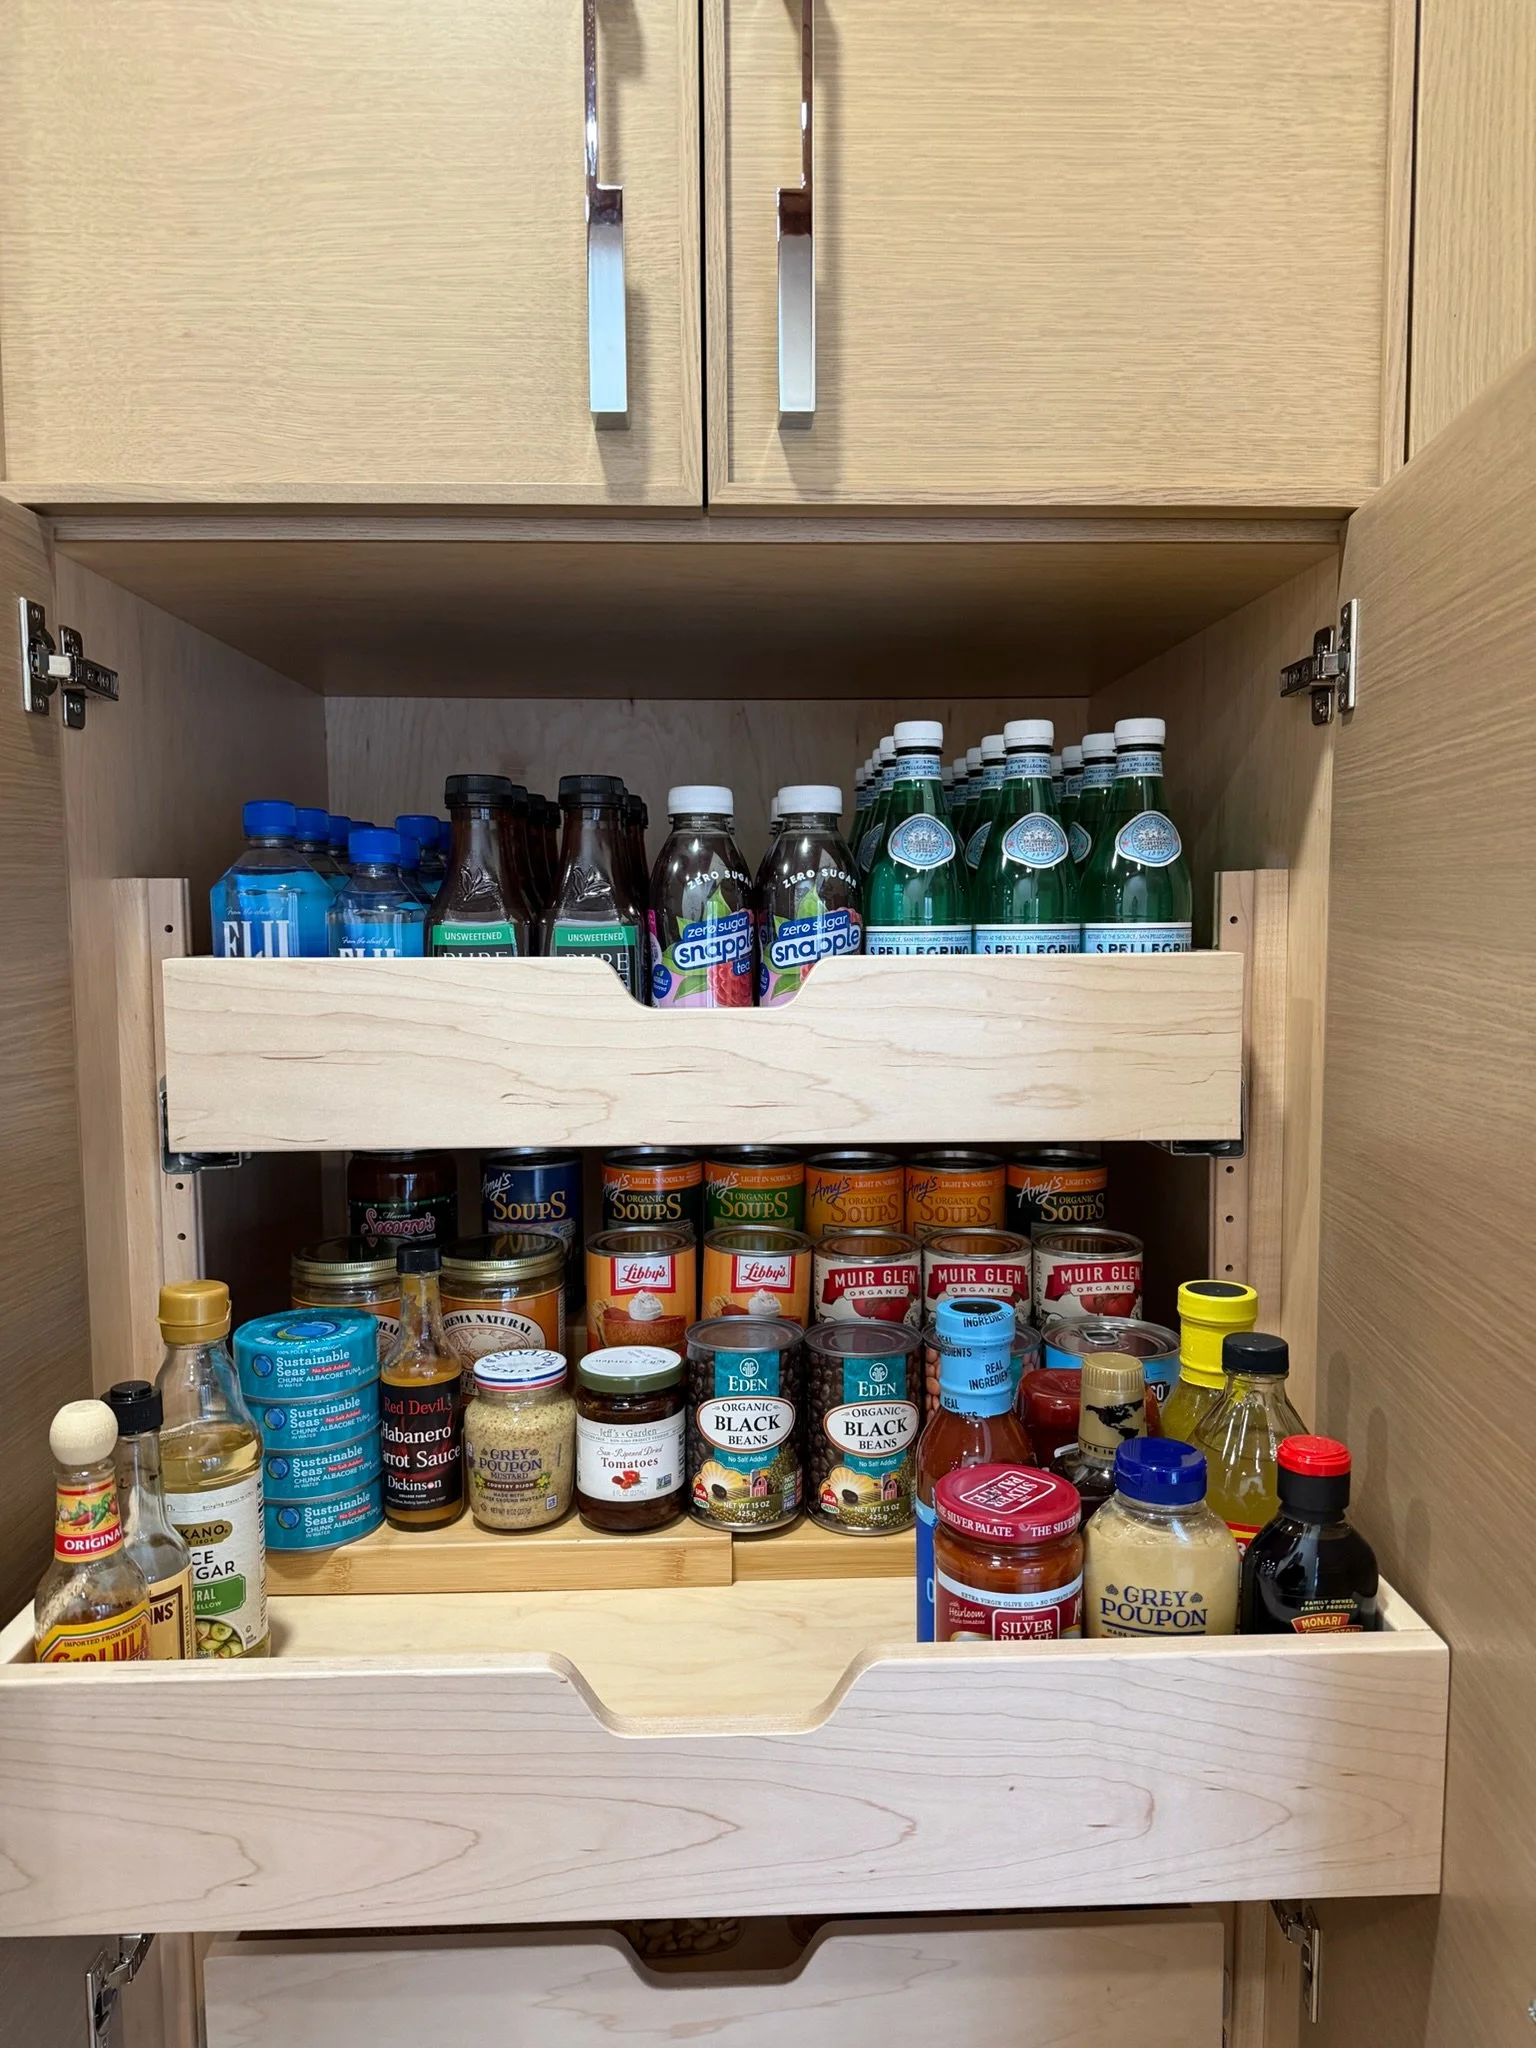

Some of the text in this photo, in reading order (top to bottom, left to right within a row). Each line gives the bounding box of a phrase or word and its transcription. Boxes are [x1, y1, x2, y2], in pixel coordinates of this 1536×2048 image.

[686, 869, 752, 890] ZERO SUGA
[782, 868, 857, 889] ZERO SUGAR
[687, 916, 748, 938] zero sugar
[782, 914, 848, 937] zero sugar
[444, 931, 503, 941] UNSWEETENED
[567, 932, 624, 942] UNSWEETENED
[775, 927, 860, 963] snapple
[481, 1172, 514, 1200] Amy's
[603, 1173, 632, 1201] Amy's
[631, 1176, 652, 1185] LIGHT
[706, 1171, 741, 1200] Amy's
[740, 1174, 760, 1183] LIGHT
[811, 1176, 852, 1208] Amy's
[905, 1175, 941, 1208] Amy's
[941, 1180, 961, 1188] LIGHT
[1016, 1175, 1064, 1209] Amy's
[626, 1194, 665, 1203] ORGANIC
[735, 1192, 773, 1201] ORGANIC
[849, 1196, 885, 1205] ORGANIC
[935, 1195, 976, 1205] ORGANIC
[1059, 1194, 1094, 1205] ORGANIC
[361, 1208, 436, 1236] Socorro's
[620, 1263, 668, 1284] Libby's
[740, 1261, 788, 1282] Libby's
[834, 1269, 915, 1288] MUIR GLEN
[938, 1268, 1022, 1285] MUIR GLEN
[1061, 1265, 1140, 1285] MUIR GLEN
[849, 1288, 905, 1297] ORGANIC
[951, 1286, 1009, 1294] ORGANIC
[1076, 1284, 1132, 1293] ORGANIC
[475, 1314, 533, 1336] NATURAL
[276, 1350, 350, 1368] Sustainable
[985, 1360, 1004, 1375] REAL
[277, 1376, 304, 1384] CHUNK
[305, 1372, 343, 1382] ALBACORE
[728, 1375, 769, 1392] EDEN
[969, 1369, 1011, 1391] INGREDIEN
[858, 1381, 897, 1397] EDEN
[289, 1396, 361, 1419] Sustainable
[384, 1395, 404, 1415] Red
[721, 1402, 773, 1413] ORGANIC
[851, 1406, 900, 1418] ORGANIC
[291, 1420, 355, 1436] CHUNK ALBACORE
[714, 1414, 781, 1432] BLACK
[844, 1416, 909, 1437] BLACK
[382, 1420, 452, 1444] Habanero
[625, 1428, 657, 1438] Garden
[728, 1434, 768, 1446] BEANS
[859, 1438, 897, 1450] BEANS
[292, 1445, 363, 1468] Sustainable
[382, 1445, 461, 1468] arrot Sauce
[490, 1448, 529, 1460] GREY
[601, 1456, 659, 1469] Tomatoes
[727, 1454, 768, 1463] No Salt Added
[868, 1459, 879, 1467] Salt
[880, 1458, 896, 1467] Added
[479, 1457, 543, 1473] POUPON
[294, 1468, 358, 1484] CHUNK ALBACORE
[490, 1472, 529, 1480] MUSTARD
[304, 1491, 370, 1517] Sustainable
[724, 1501, 737, 1509] NET
[751, 1501, 759, 1509] 15
[761, 1500, 770, 1508] OZ
[823, 1493, 836, 1503] USA
[305, 1515, 366, 1534] CHUNK ALBACORE
[947, 1511, 974, 1530] SILVER
[1030, 1516, 1077, 1537] THE SILVER
[961, 1591, 979, 1603] EXTRA
[980, 1597, 1002, 1607] VIRGIN
[1003, 1600, 1022, 1608] OLIVE
[1123, 1585, 1190, 1608] GREY
[948, 1607, 986, 1619] Heirloom
[1100, 1597, 1208, 1628] POUPON
[1000, 1619, 1053, 1634] SILVER
[1301, 1616, 1342, 1629] MONARI
[64, 1637, 101, 1648] IMPORTED
[101, 1631, 121, 1643] FROM
